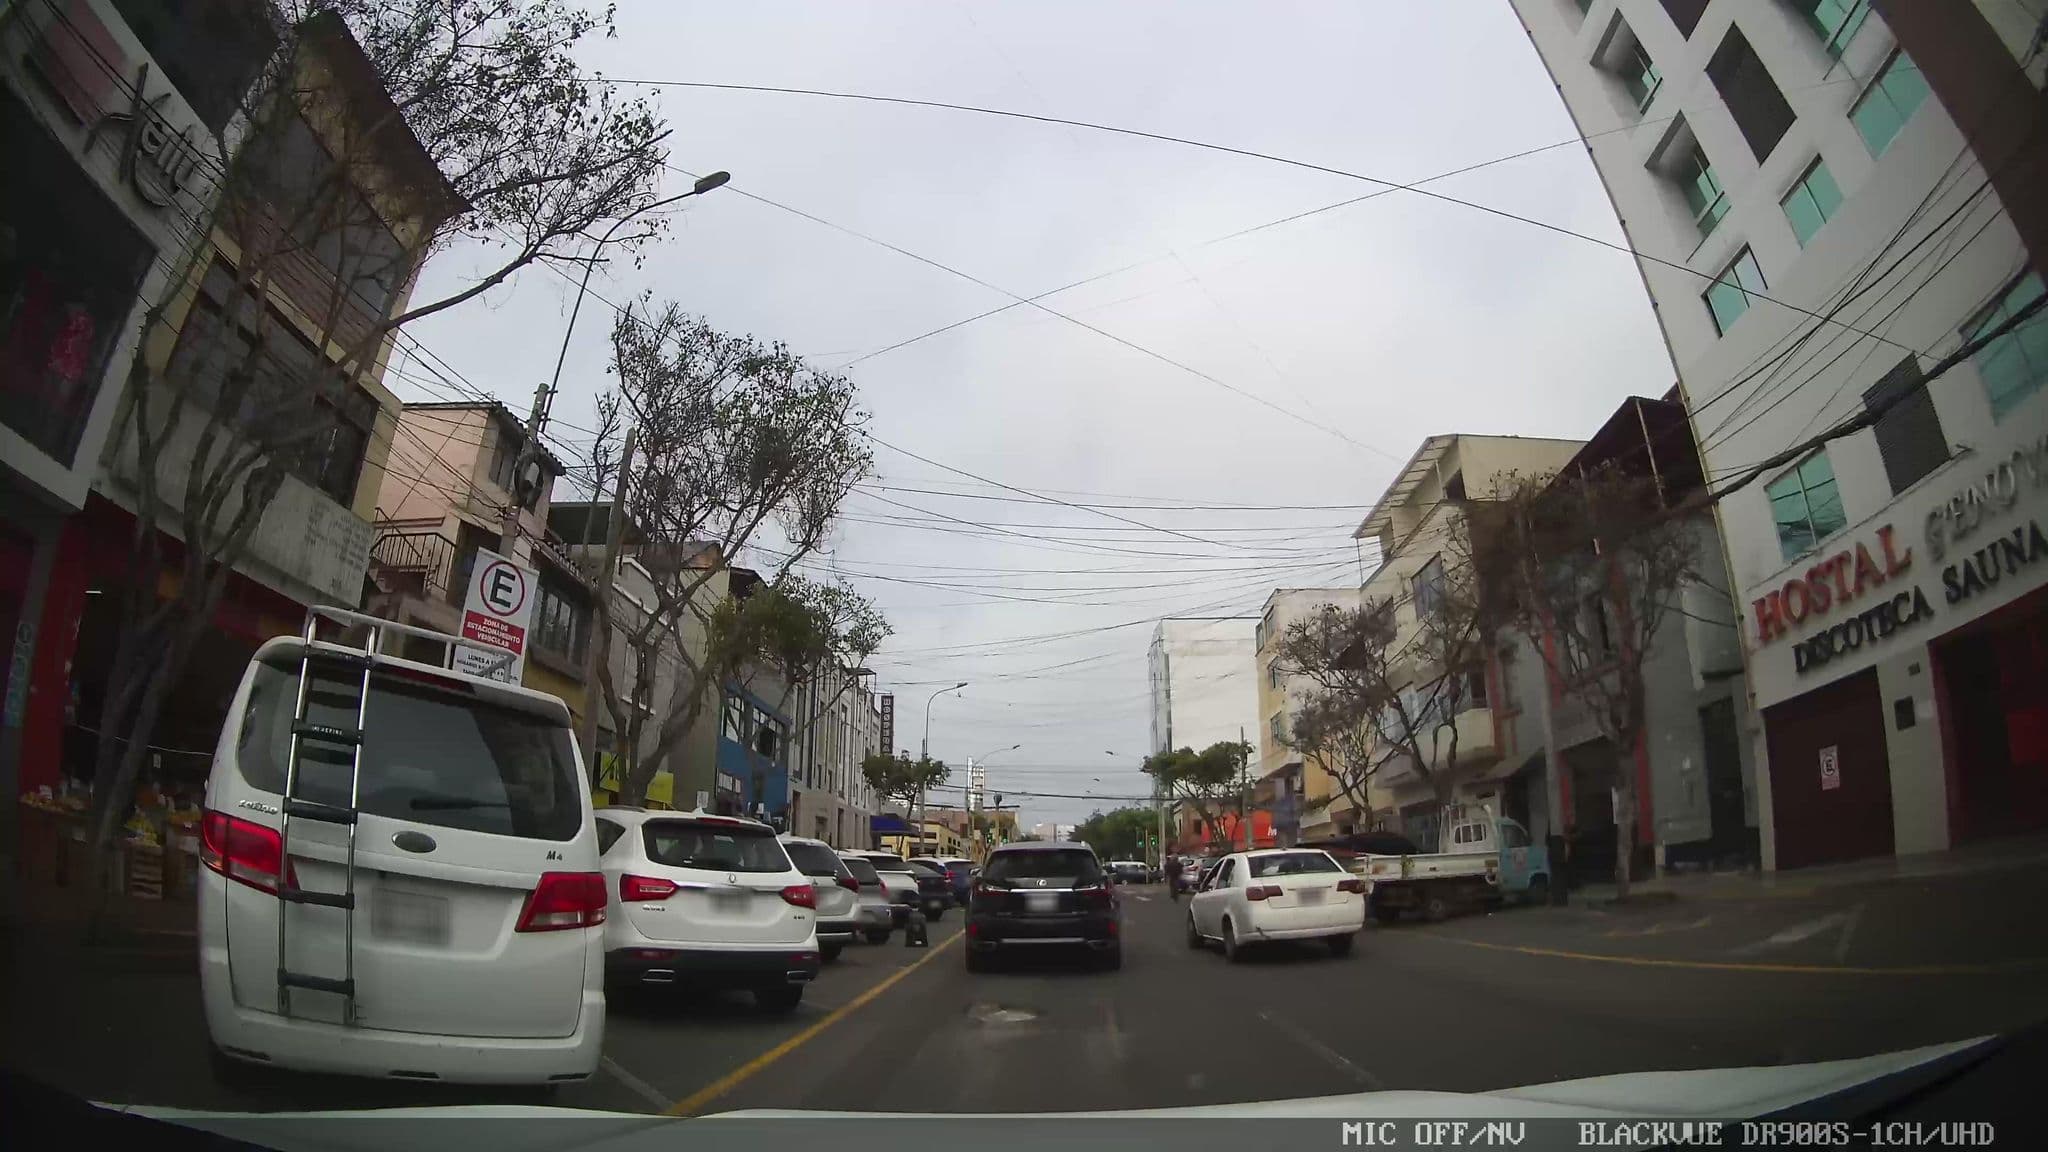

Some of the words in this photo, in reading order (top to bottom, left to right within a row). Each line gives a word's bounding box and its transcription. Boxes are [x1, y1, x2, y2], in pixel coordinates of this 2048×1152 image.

[1752, 523, 1912, 643] HOSTAL
[1924, 436, 2048, 562] GENOV
[490, 568, 516, 608] E
[1792, 585, 1934, 673] DISCOTECA
[1942, 519, 2048, 605] SAUNA
[467, 621, 520, 644] ESTACIONAMIENTO
[477, 633, 510, 648] VEHICULAR
[483, 618, 500, 629] ZONA
[500, 623, 509, 632] DE
